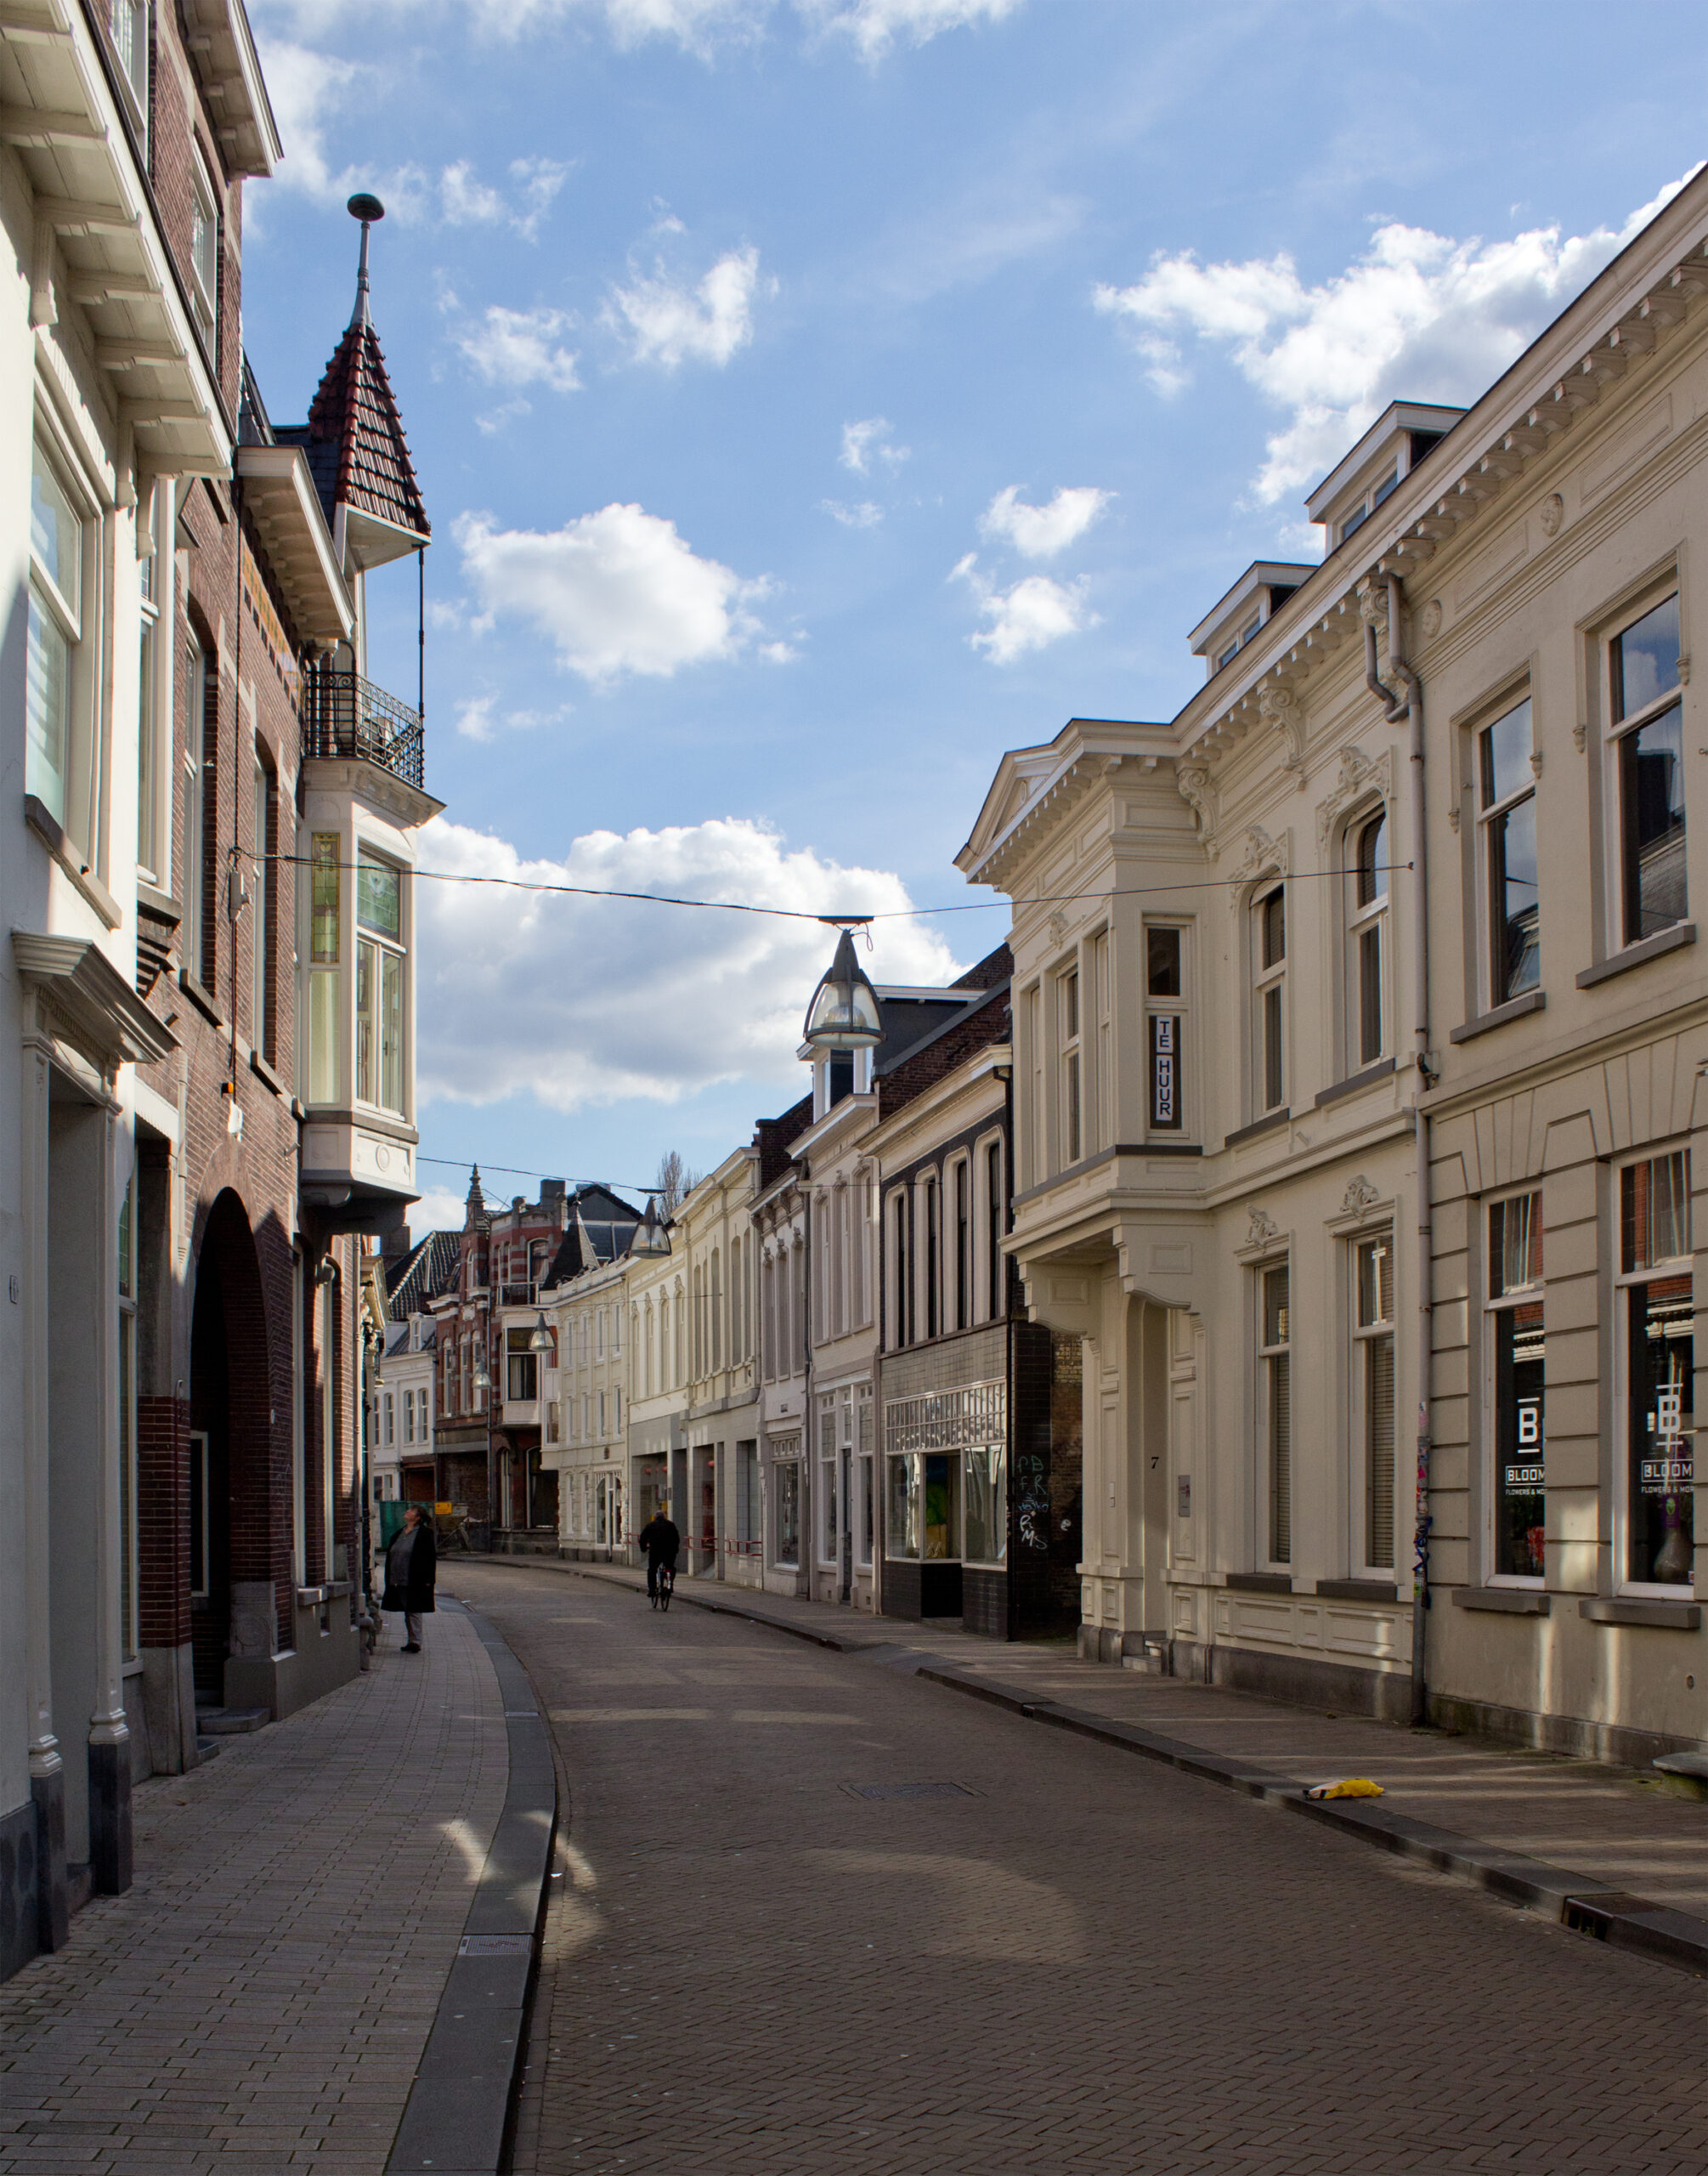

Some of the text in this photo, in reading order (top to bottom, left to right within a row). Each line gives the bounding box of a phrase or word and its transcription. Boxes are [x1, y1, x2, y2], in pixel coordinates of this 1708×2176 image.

[1159, 1021, 1170, 1115] TE HUUR
[1519, 1407, 1538, 1443] B
[1658, 1394, 1681, 1435] B
[1151, 1457, 1159, 1469] 7
[1507, 1469, 1545, 1482] BLOOM
[1643, 1463, 1693, 1477] BLOOM
